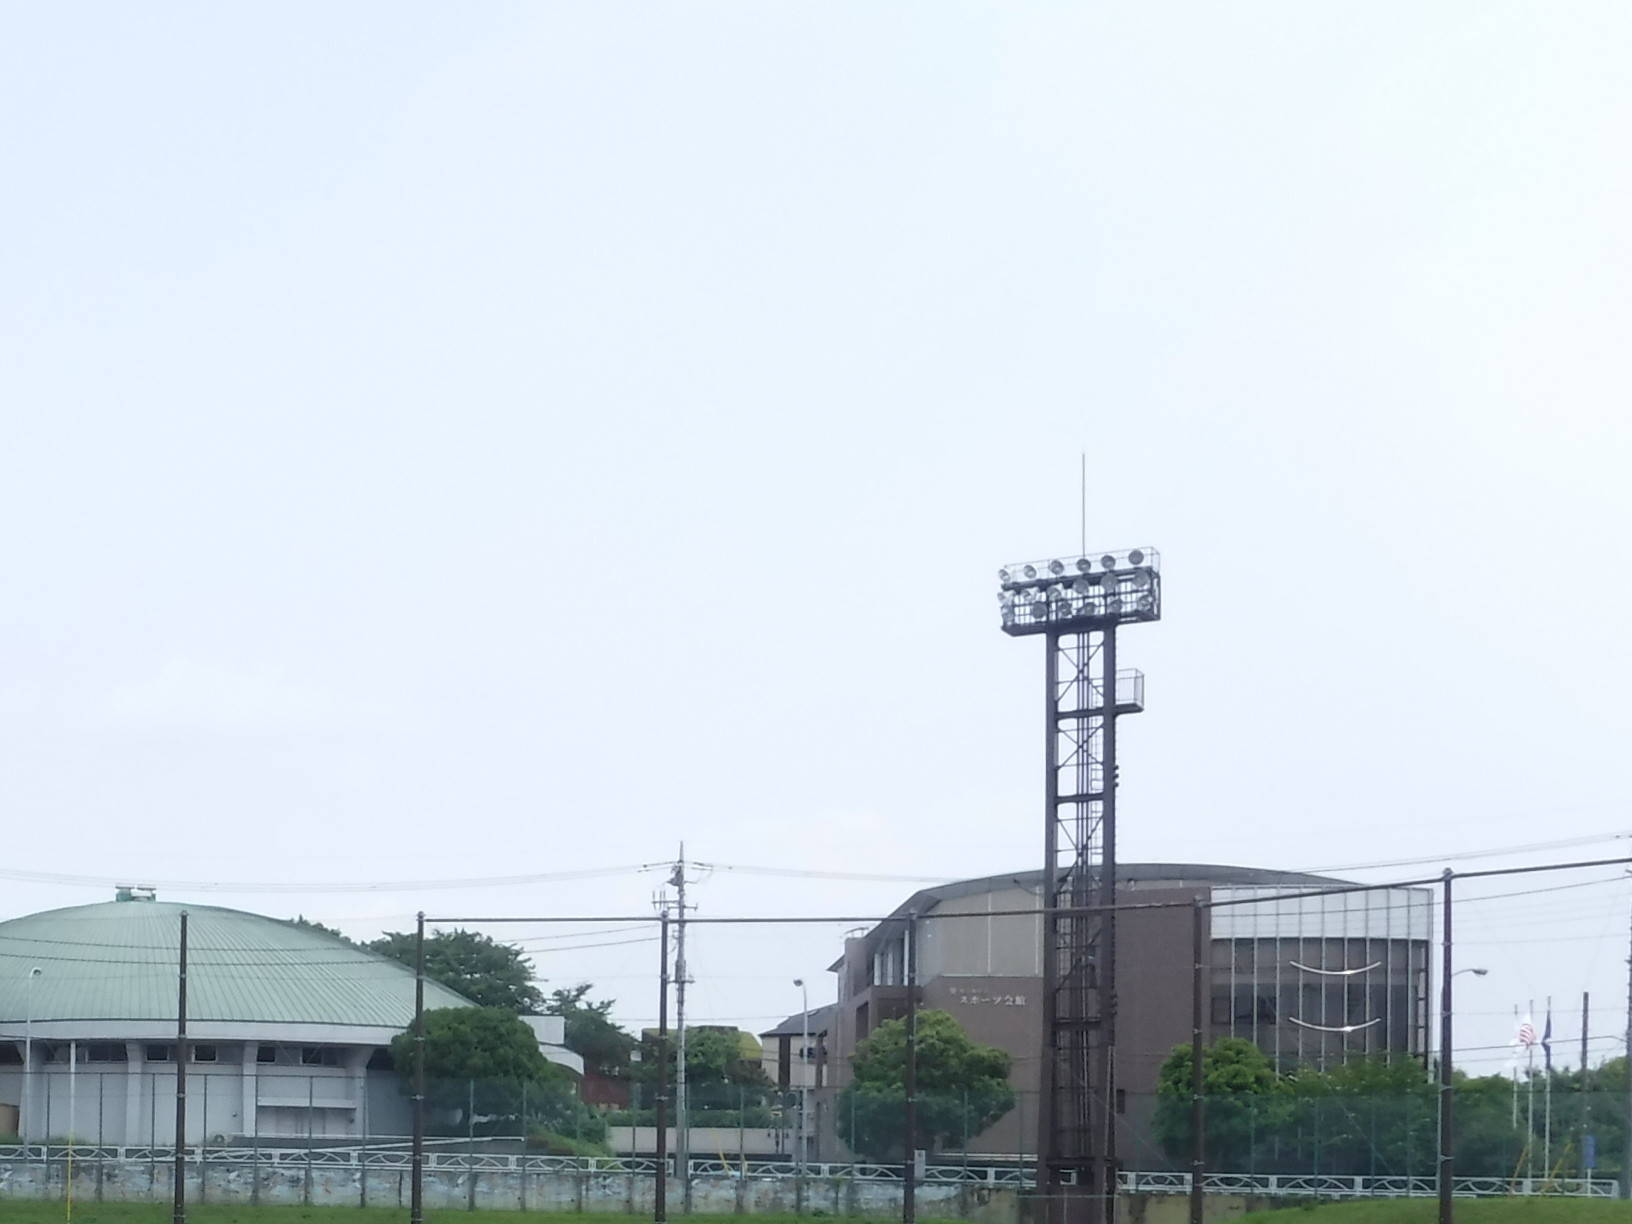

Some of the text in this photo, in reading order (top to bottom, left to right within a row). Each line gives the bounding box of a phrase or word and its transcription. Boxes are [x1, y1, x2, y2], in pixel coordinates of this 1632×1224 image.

[960, 995, 1026, 1006] スポーツ会館
